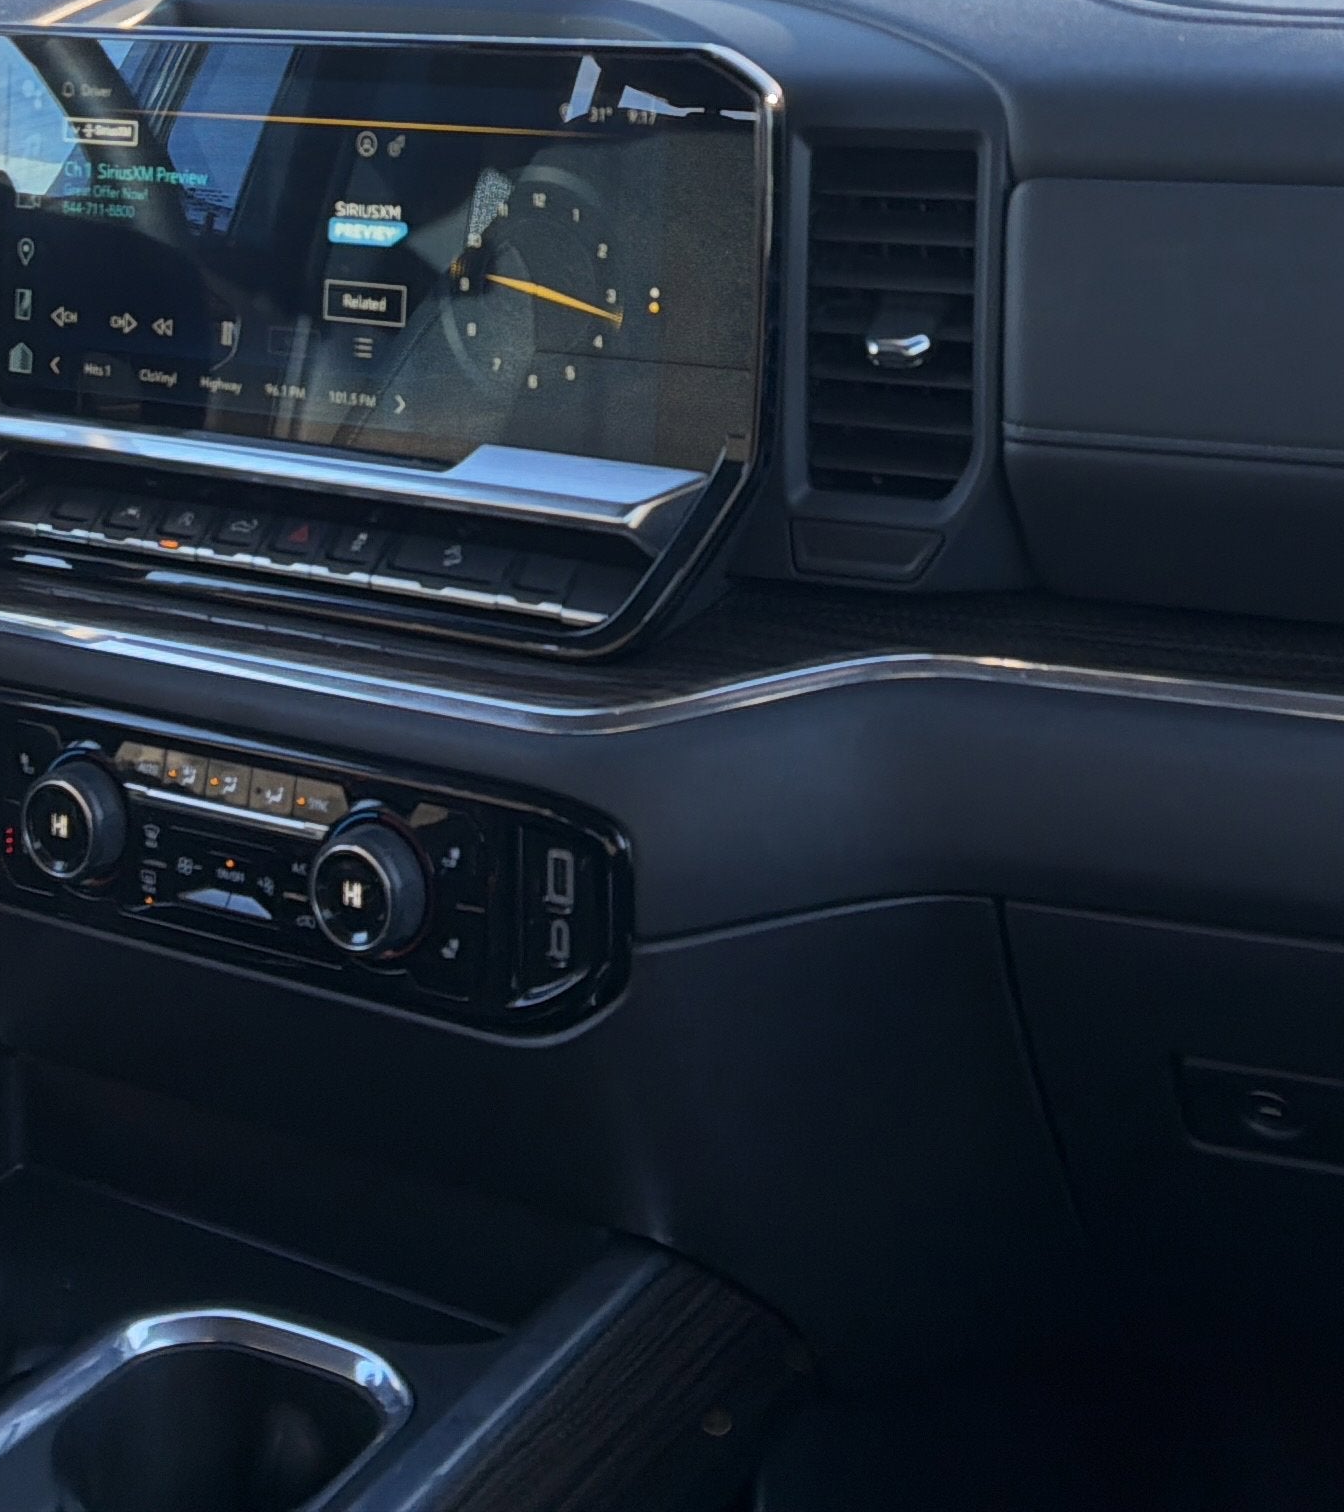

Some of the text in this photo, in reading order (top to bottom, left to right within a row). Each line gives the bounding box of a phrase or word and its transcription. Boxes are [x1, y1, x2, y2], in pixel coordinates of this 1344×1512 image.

[64, 160, 82, 178] Ch
[96, 162, 154, 182] SiriusXM
[157, 165, 209, 186] Preview
[92, 184, 119, 199] Offer
[532, 192, 547, 208] 12
[597, 243, 608, 259] 2
[342, 293, 387, 313] Related
[606, 288, 617, 304] 3
[593, 334, 603, 349] 4
[83, 362, 103, 377] Hits
[199, 375, 243, 396] Highway
